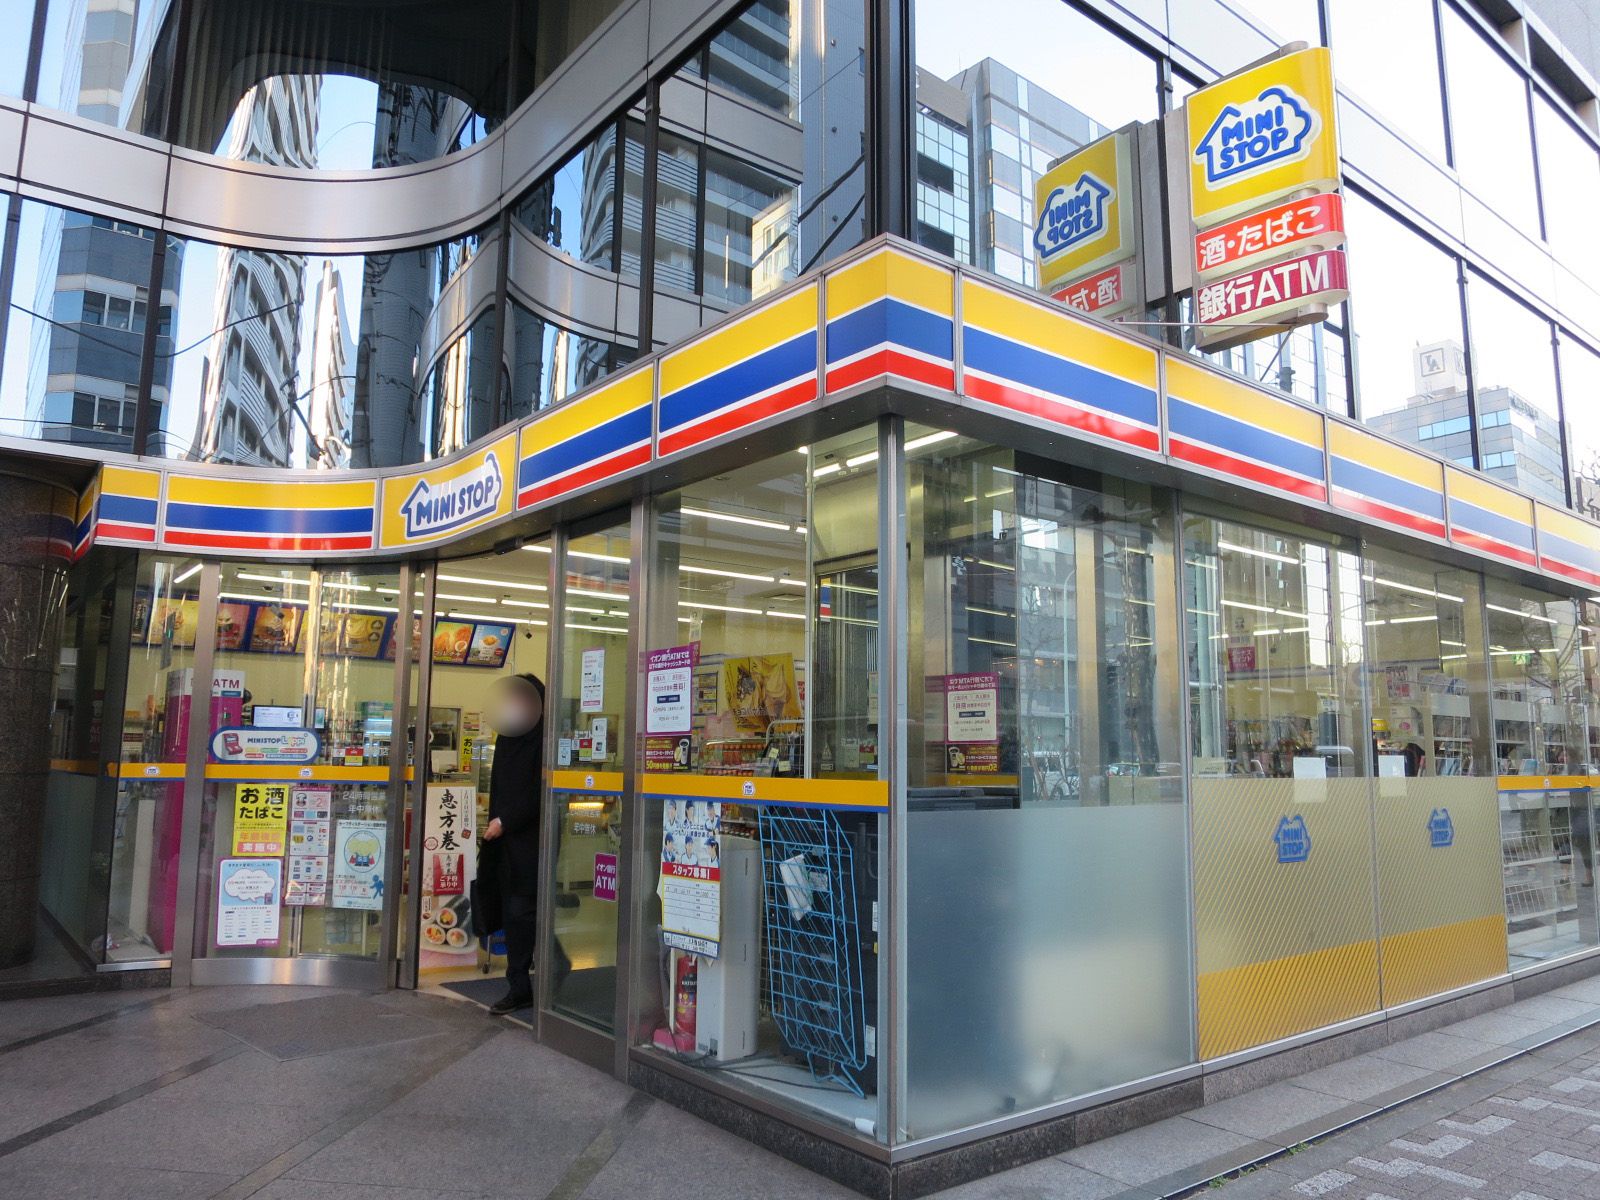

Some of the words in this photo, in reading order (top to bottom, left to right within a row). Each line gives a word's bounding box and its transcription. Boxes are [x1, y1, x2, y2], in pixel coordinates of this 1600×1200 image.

[1221, 105, 1284, 147] MINI
[1220, 128, 1289, 169] STOP
[1200, 205, 1324, 269] 酒・たばこ
[1199, 255, 1330, 323] 銀行ATM
[213, 679, 239, 688] ATM
[241, 787, 285, 805] お酒
[240, 806, 283, 819] たばこ
[440, 788, 460, 850] 恵方巻
[1433, 831, 1450, 843] STOP
[1282, 842, 1304, 856] STOP
[595, 875, 616, 892] ATM
